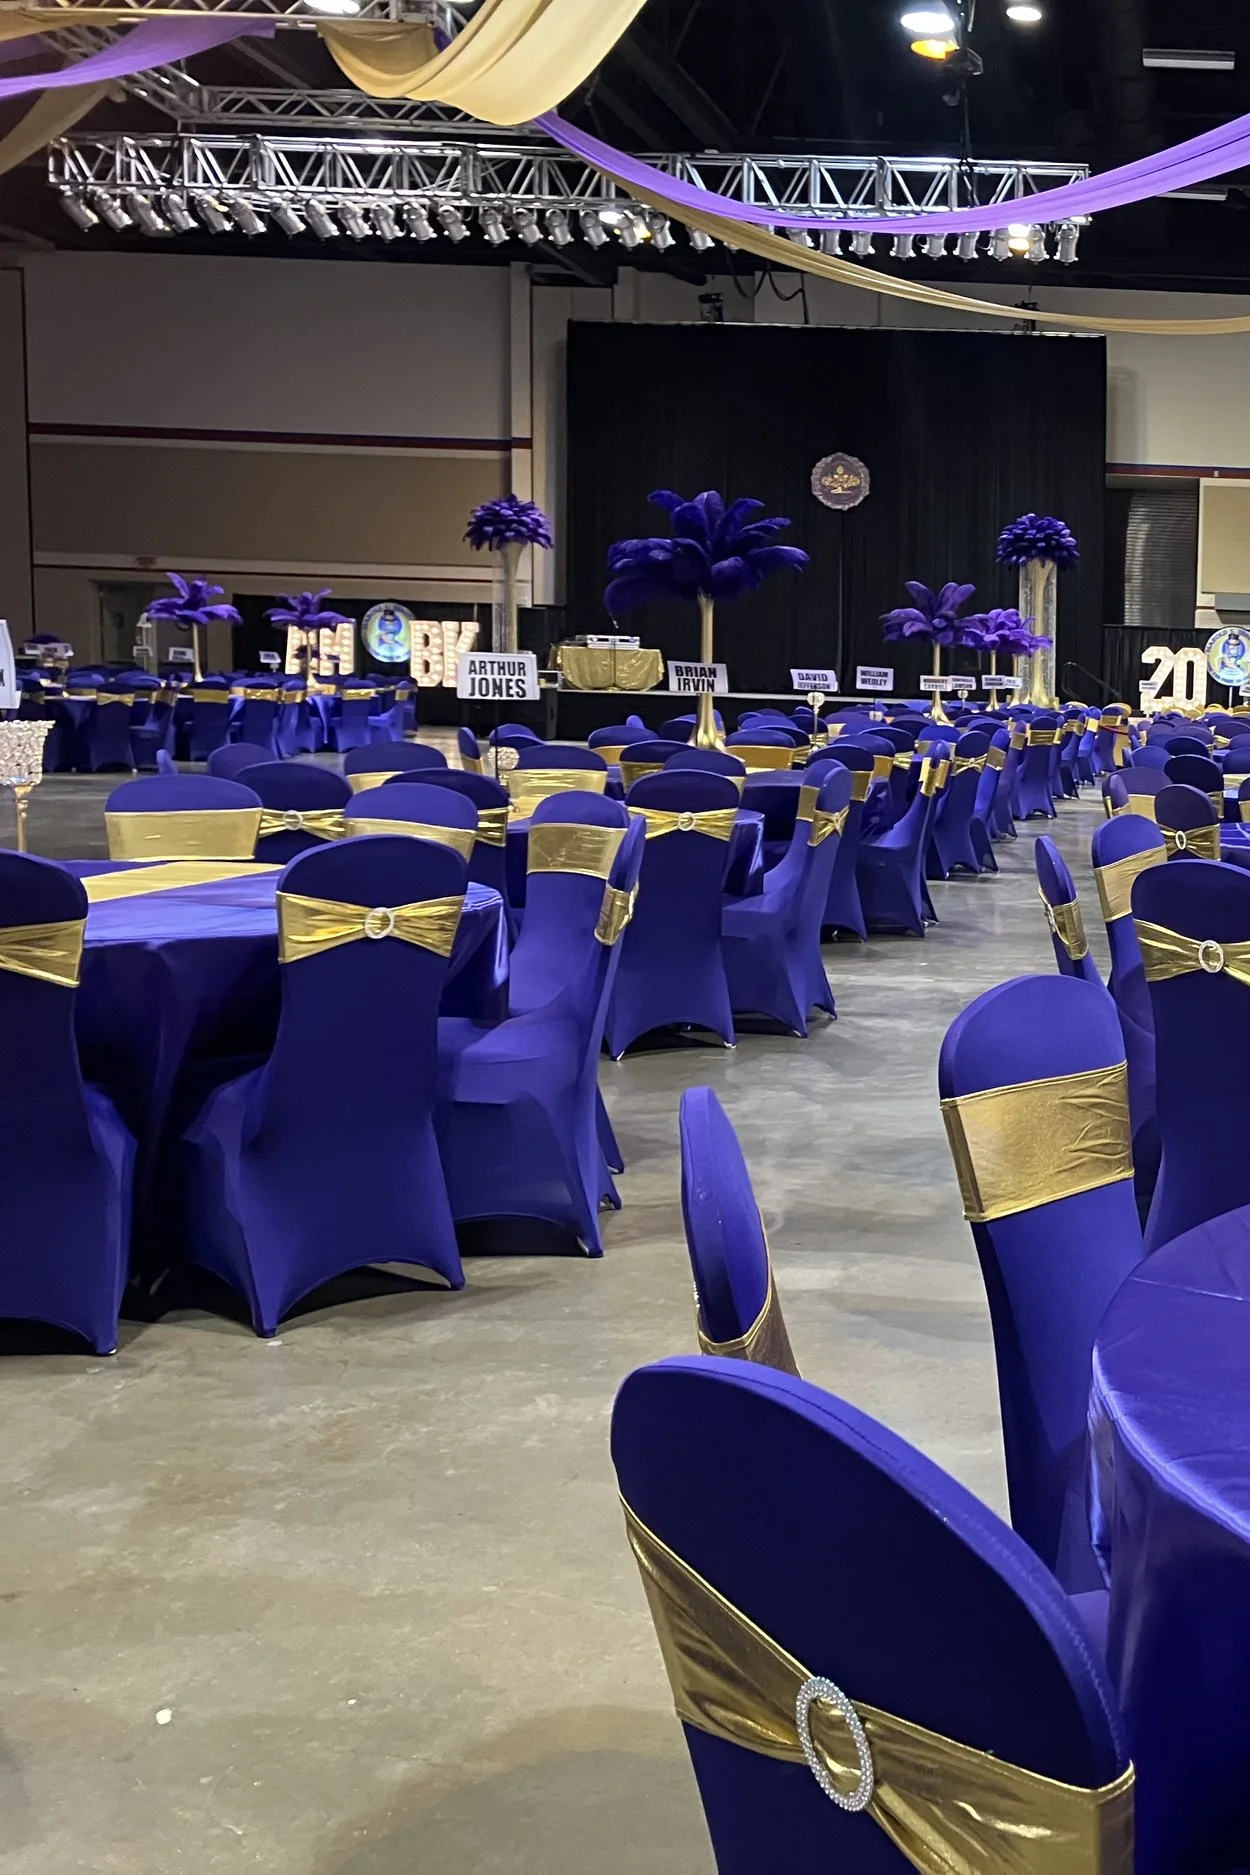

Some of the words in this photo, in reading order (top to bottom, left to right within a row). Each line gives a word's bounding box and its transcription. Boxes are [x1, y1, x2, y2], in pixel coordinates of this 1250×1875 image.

[468, 660, 526, 676] ARTHUR
[674, 665, 717, 678] BRIAN
[677, 678, 715, 692] IRVIN
[797, 673, 828, 682] DAVID
[1140, 646, 1208, 712] 20
[469, 677, 526, 698] JONES
